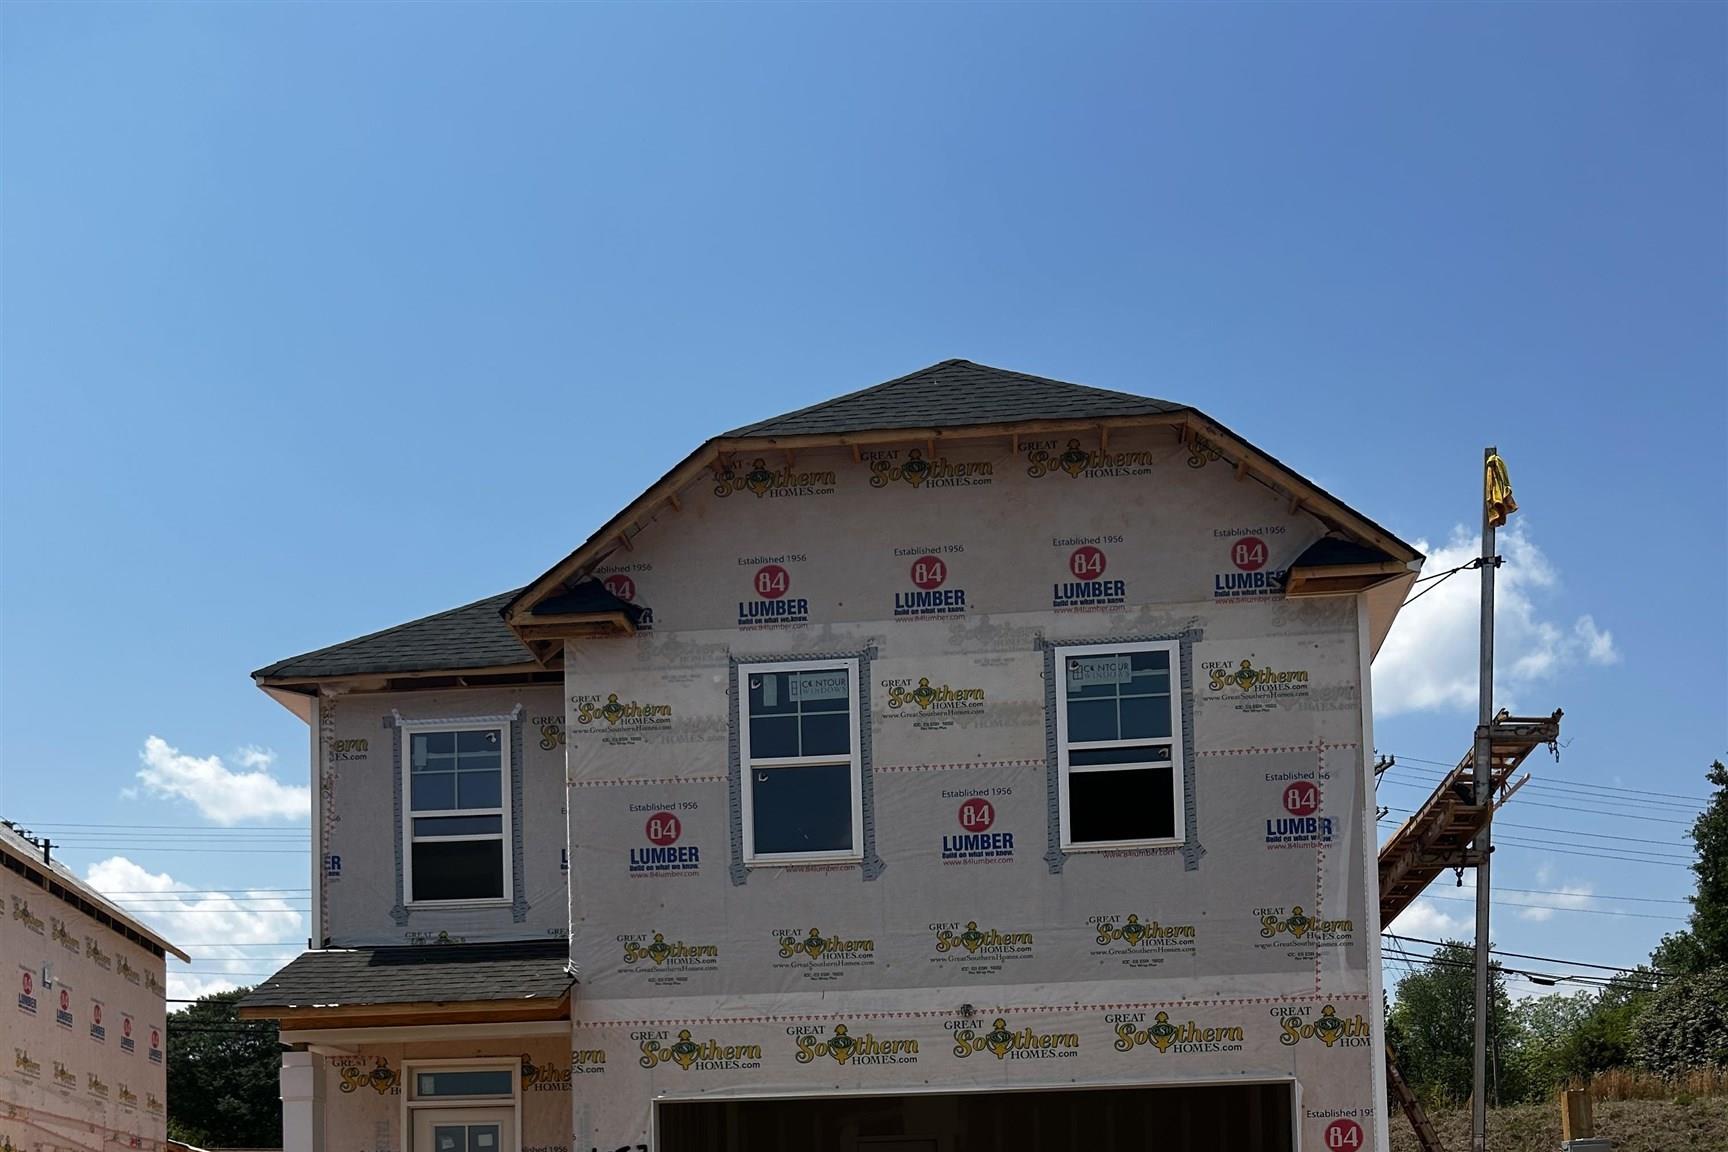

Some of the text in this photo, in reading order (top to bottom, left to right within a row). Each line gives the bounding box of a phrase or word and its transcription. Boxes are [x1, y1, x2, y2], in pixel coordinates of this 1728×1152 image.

[1085, 467, 1152, 479] HOMES.com
[926, 478, 992, 488] HOMES.com
[1214, 526, 1286, 537] Established 1956
[1053, 535, 1123, 547] Established 1956
[894, 545, 964, 556] Established 1956
[1235, 544, 1264, 565] 84
[738, 554, 807, 566] Established 1956
[1074, 553, 1102, 574] 84
[598, 563, 652, 574] ablished 1956
[915, 563, 943, 583] 84
[759, 572, 786, 592] 84
[1054, 581, 1125, 600] LUMBER
[895, 589, 965, 608] LUMBER
[739, 599, 808, 617] LUMBER
[1201, 660, 1233, 670] GREAT
[881, 679, 912, 687] GREAT
[1209, 666, 1309, 691] Southern
[1254, 684, 1308, 692] HOMES.com
[571, 695, 602, 704] GREAT
[888, 685, 985, 709] Southern
[932, 701, 983, 710] HOMES.com
[578, 701, 672, 724] Southern
[620, 717, 671, 726] HOMES.com
[1265, 771, 1315, 781] Established
[942, 786, 1012, 798] Established 1956
[1288, 788, 1316, 809] 84
[629, 802, 698, 812] Established 1956
[963, 805, 990, 826] 84
[650, 819, 677, 839] 84
[943, 832, 1014, 851] LUMBER
[630, 847, 699, 865] LUMBER
[1253, 907, 1285, 916] GREAT
[1089, 915, 1120, 923] GREAT
[929, 922, 960, 930] GREAT
[771, 929, 802, 937] GREAT
[1096, 921, 1195, 945] Southern
[936, 928, 1033, 952] Southern
[624, 941, 718, 964] Southern
[779, 935, 874, 958] Southern
[822, 952, 873, 960] HOMES.com
[1269, 1006, 1312, 1018] GREAT
[944, 1019, 985, 1030] GREAT
[1105, 1013, 1146, 1024] GREAT
[630, 1031, 669, 1040] GREAT
[786, 1025, 825, 1036] GREAT
[1114, 1021, 1243, 1052] Southern
[1280, 1015, 1370, 1046] South
[795, 1034, 919, 1064] Southern
[953, 1028, 1079, 1058] Southern
[1174, 1042, 1242, 1053] HOMES.com
[639, 1039, 762, 1068] Southern
[1011, 1049, 1078, 1059] HOMES.com
[695, 1061, 761, 1071] HOMES.com
[852, 1055, 918, 1065] HOMES.com
[1307, 1109, 1357, 1118] Established
[1330, 1126, 1358, 1148] 84
[549, 1145, 568, 1152] 1956
